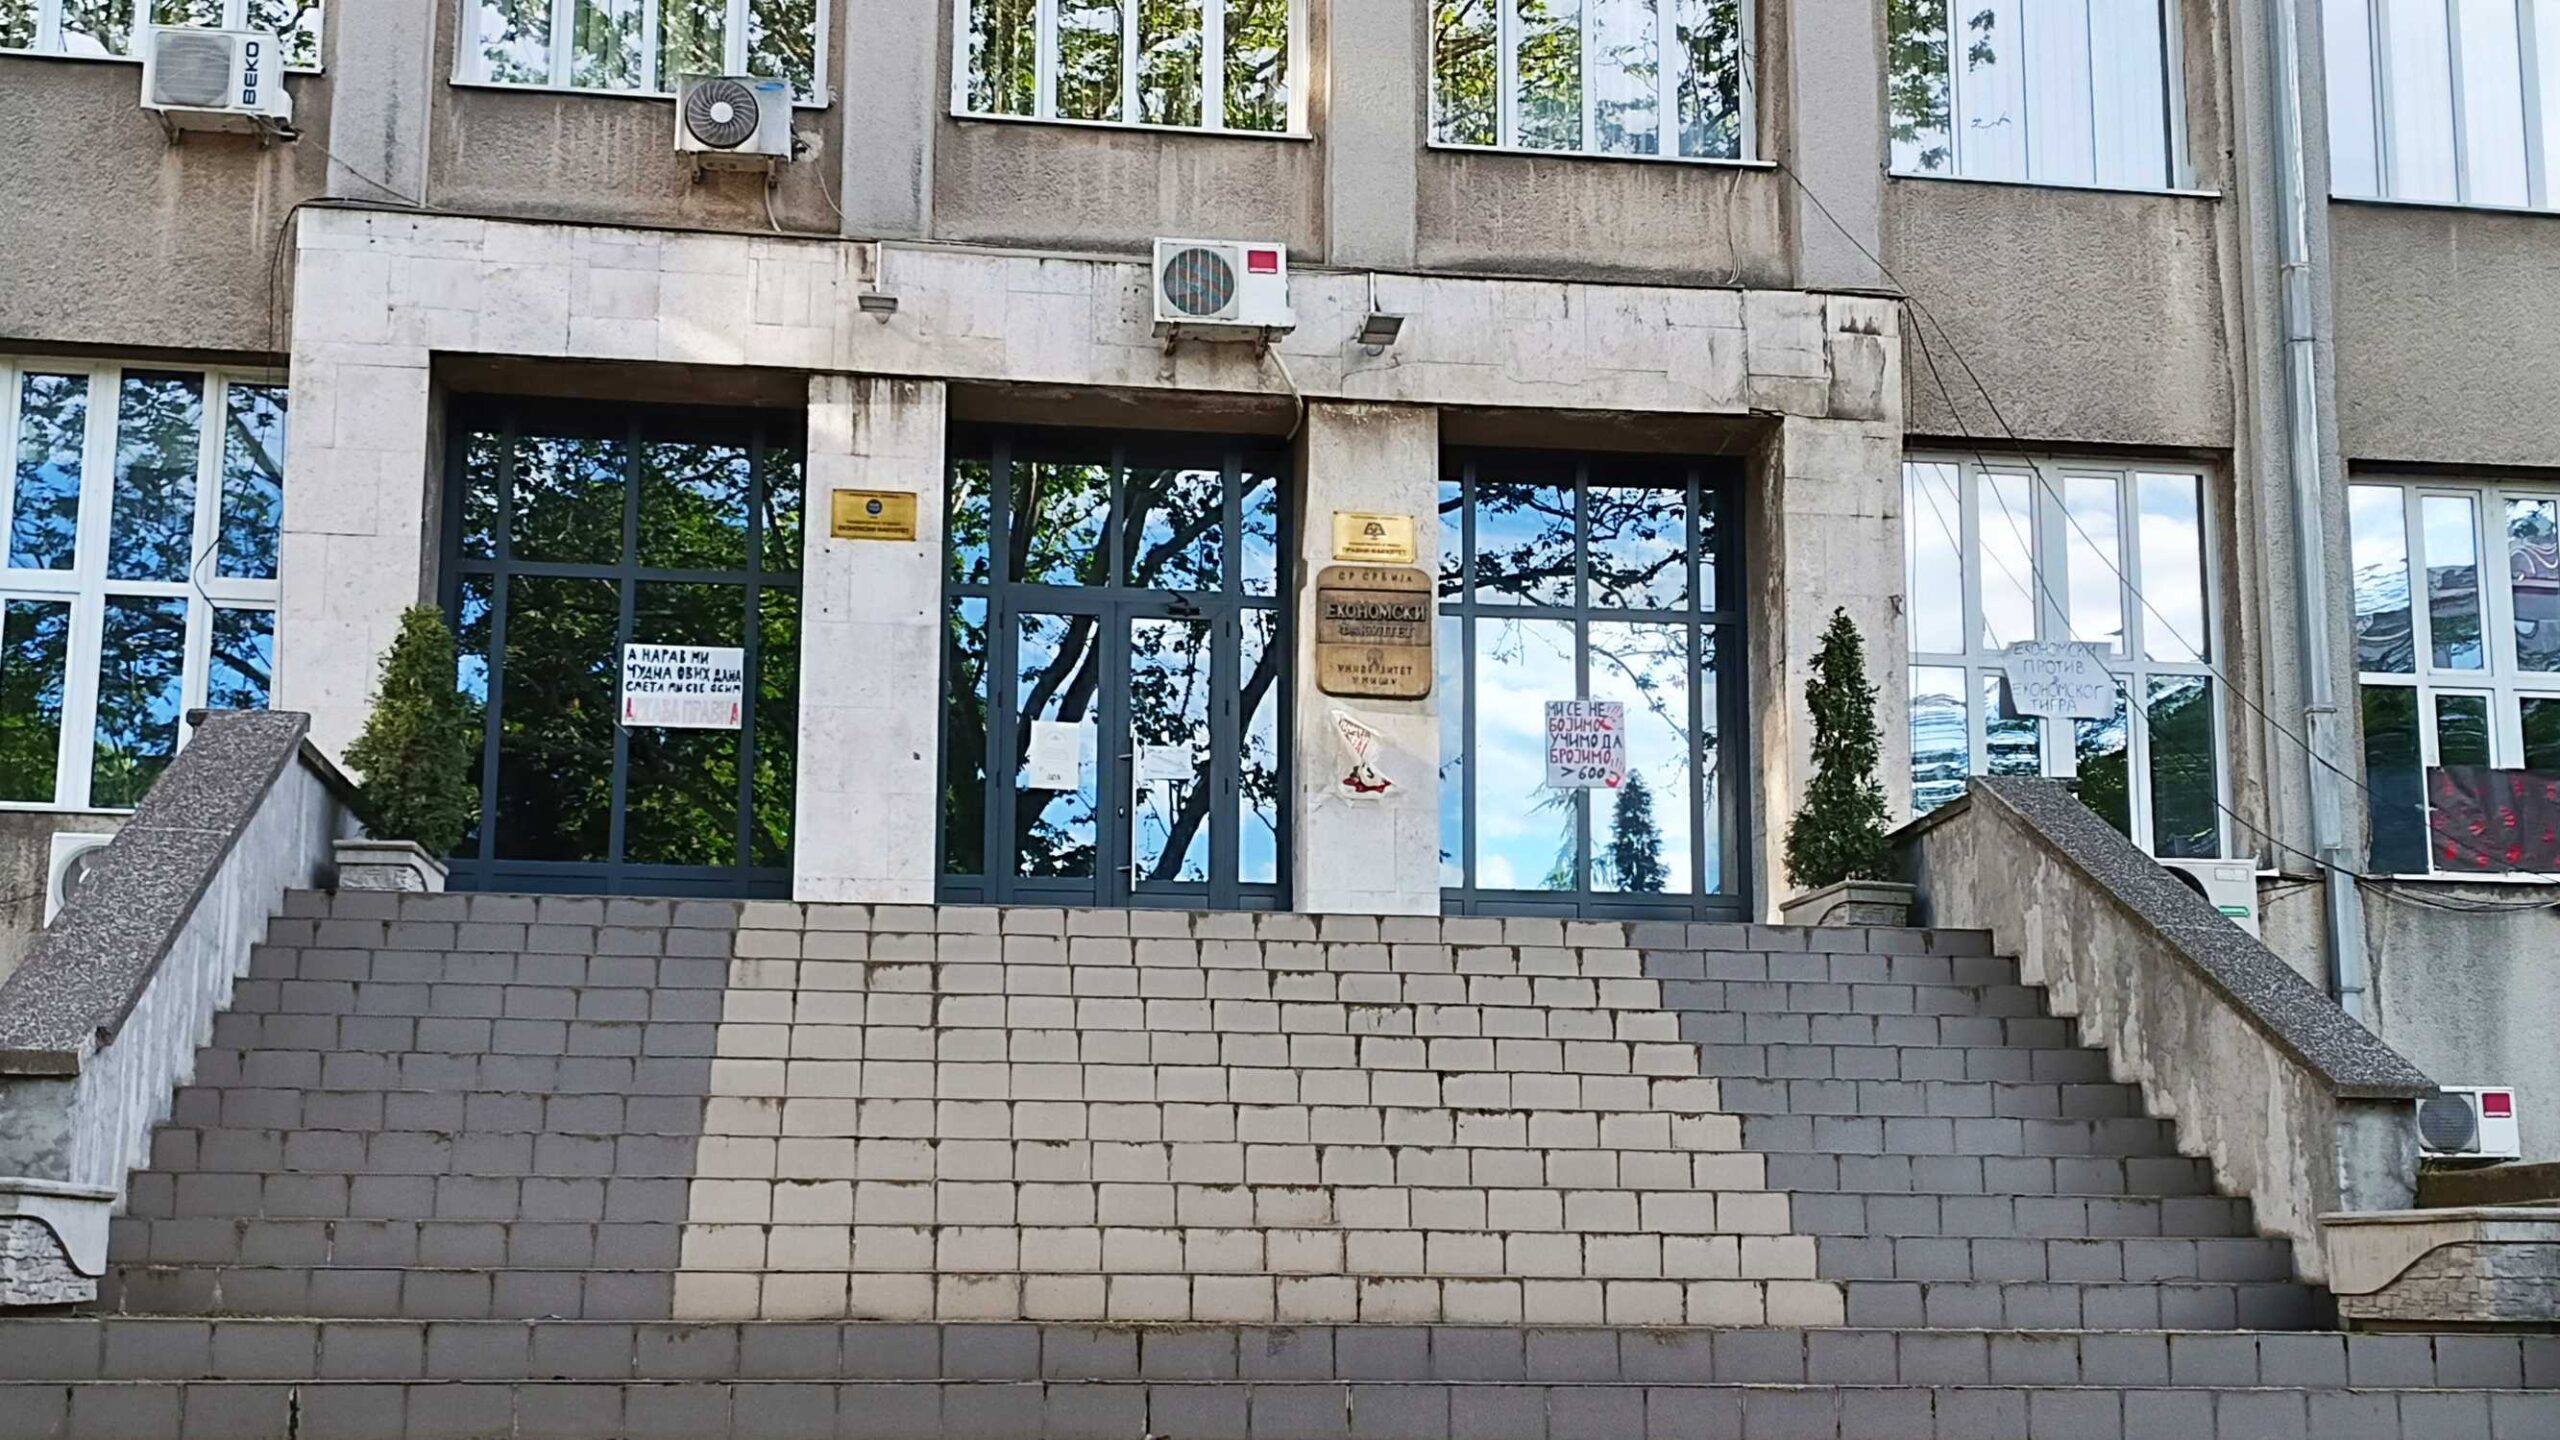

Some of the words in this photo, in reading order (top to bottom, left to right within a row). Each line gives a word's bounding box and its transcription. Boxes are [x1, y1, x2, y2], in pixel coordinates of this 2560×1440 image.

[242, 41, 260, 106] BEKO
[1338, 571, 1355, 581] СР
[1362, 572, 1413, 583] СРБИЈА
[1325, 603, 1427, 622] ЕКОНОМСКИ
[628, 648, 637, 660] А
[642, 648, 686, 664] НАРАВ
[691, 651, 710, 665] МИ
[627, 664, 672, 680] ЧУДНА
[677, 666, 710, 682] ОВИХ
[713, 668, 742, 683] ДАНА
[2023, 659, 2086, 674] ПРОТИВ
[626, 681, 664, 693] СМЕТА
[686, 683, 706, 694] СВЕ
[710, 684, 741, 694] ОСИМ
[2012, 682, 2104, 700] ЕКОНОМСКОГ
[1547, 702, 1564, 716] МИ
[1567, 702, 1581, 716] СЕ
[1589, 702, 1608, 718] НЕ
[2030, 698, 2078, 713] ТИГРА
[1548, 718, 1600, 732] БОЈИМО
[1550, 733, 1598, 748] УЧИМО
[1601, 734, 1622, 750] ДА
[1550, 748, 1611, 764] БРОЈИМО
[1578, 766, 1606, 780] 600
